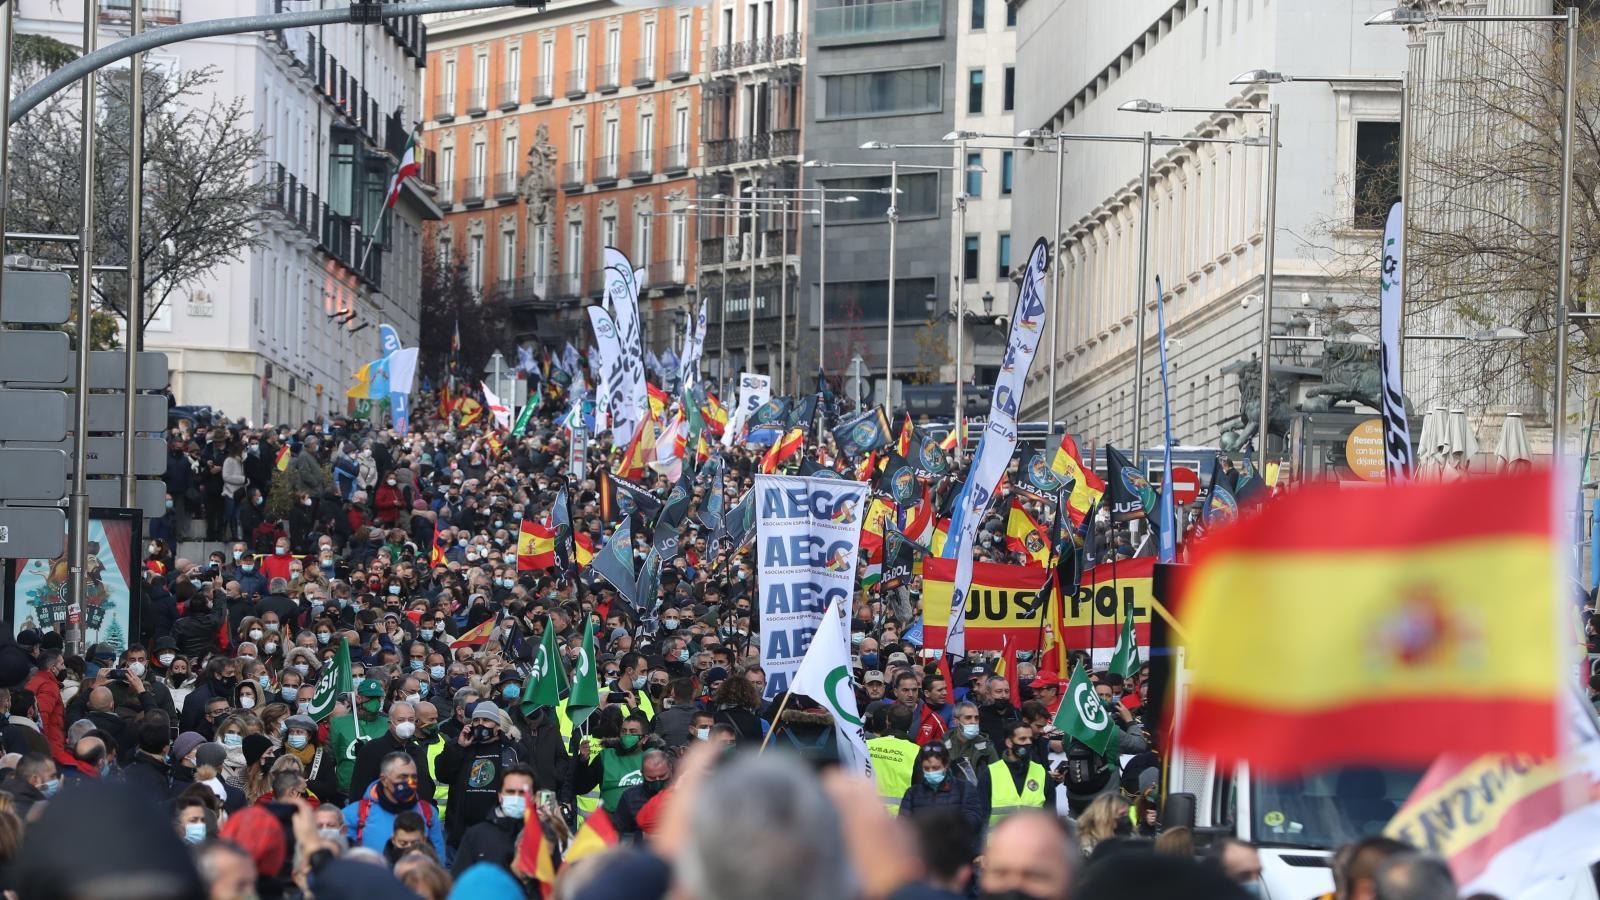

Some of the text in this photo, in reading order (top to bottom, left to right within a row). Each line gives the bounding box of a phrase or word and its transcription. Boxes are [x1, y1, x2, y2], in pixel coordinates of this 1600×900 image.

[762, 487, 861, 525] AEGC
[1014, 480, 1058, 503] JUSAPO
[763, 534, 855, 573] AEGC
[870, 753, 903, 763] EGURIDAD
